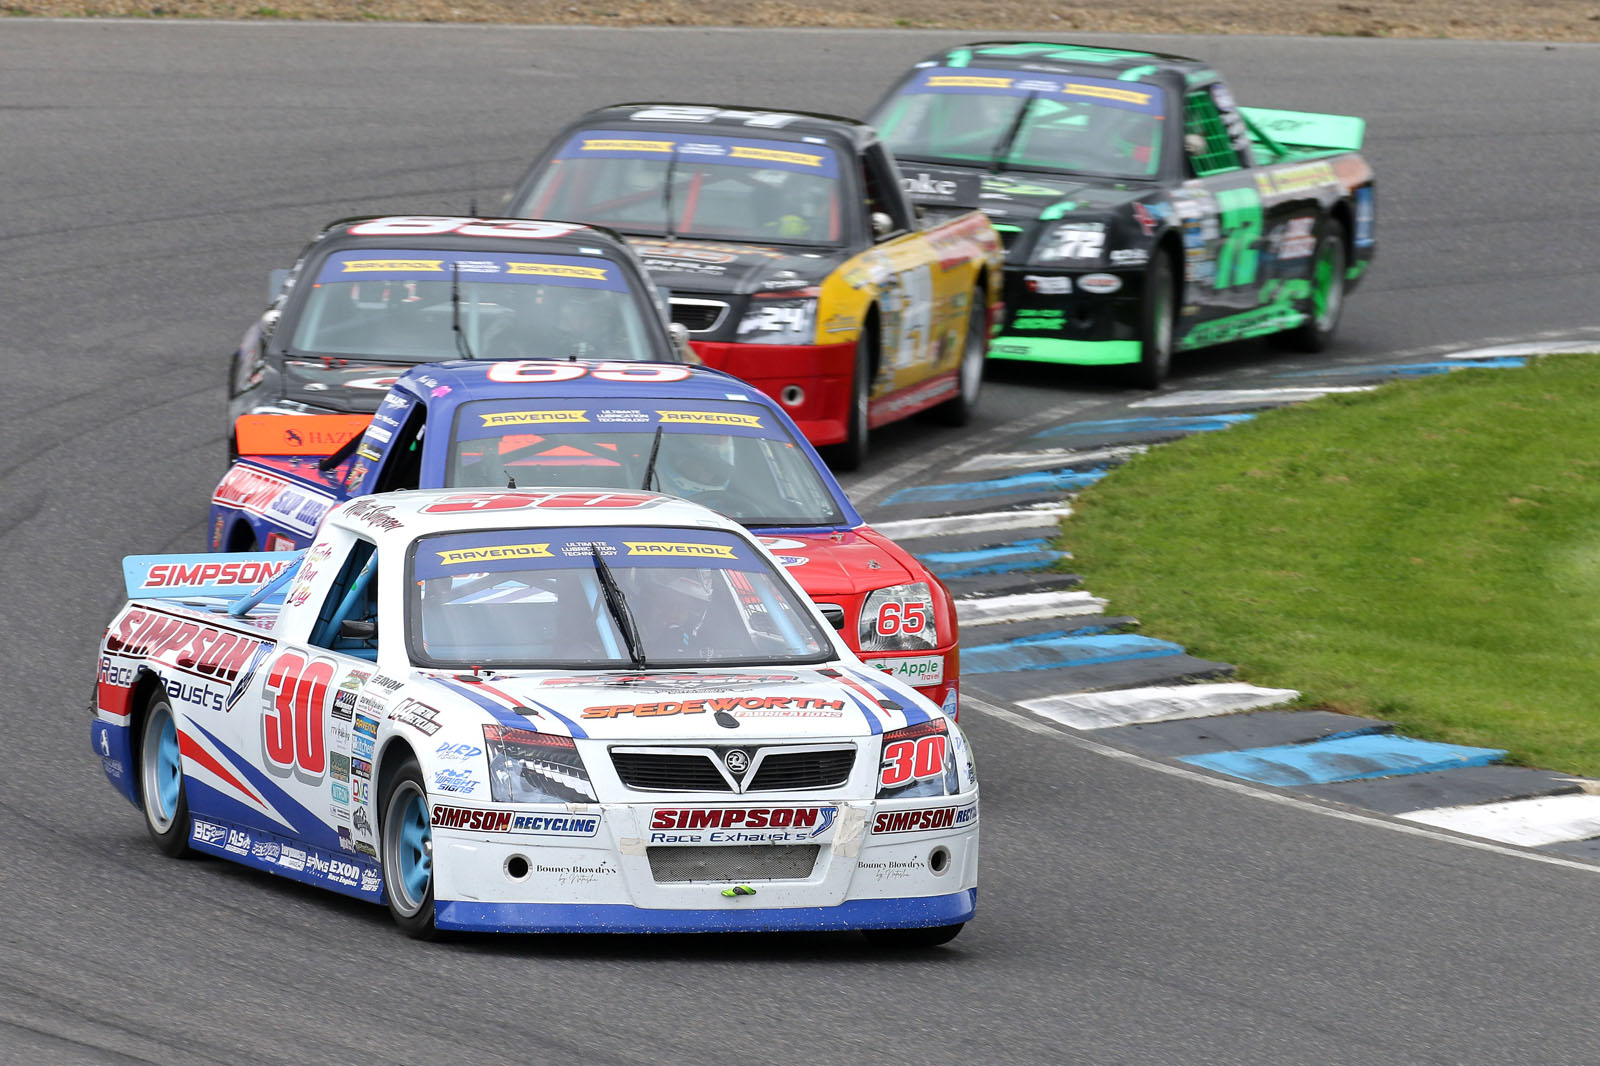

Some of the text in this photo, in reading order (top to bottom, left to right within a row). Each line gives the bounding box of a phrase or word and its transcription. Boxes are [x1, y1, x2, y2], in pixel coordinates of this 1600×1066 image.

[487, 361, 690, 382] 65
[491, 412, 579, 424] RAVENOL
[667, 413, 751, 424] RAVENOL
[309, 431, 353, 444] HAZ
[418, 493, 670, 514] 30
[448, 548, 542, 561] RAVENOL
[635, 544, 730, 556] RAVENOL
[144, 561, 283, 587] SIMPSON
[876, 602, 926, 636] 65
[107, 608, 260, 683] SIMPSON
[102, 656, 132, 687] Race
[898, 660, 939, 677] Apple
[920, 672, 941, 681] Travel
[376, 676, 405, 692] AVON
[262, 652, 334, 776] 30
[581, 695, 845, 718] SPEDEWORTH
[734, 710, 843, 718] FABRICATIONS
[881, 737, 946, 788] 30
[435, 775, 480, 788] WRIGHT
[438, 783, 475, 793] SIGNS
[432, 806, 596, 832] SIMPSON RECYCLING
[652, 808, 818, 829] SIMPSON
[873, 808, 956, 832] SIMPSON
[651, 832, 806, 843] Race Exhausts
[329, 860, 360, 880] EXON
[537, 865, 616, 875] Bouncy Blowdrys
[858, 861, 925, 870] Bouncy Blowdrys
[327, 872, 358, 887] Race Engines
